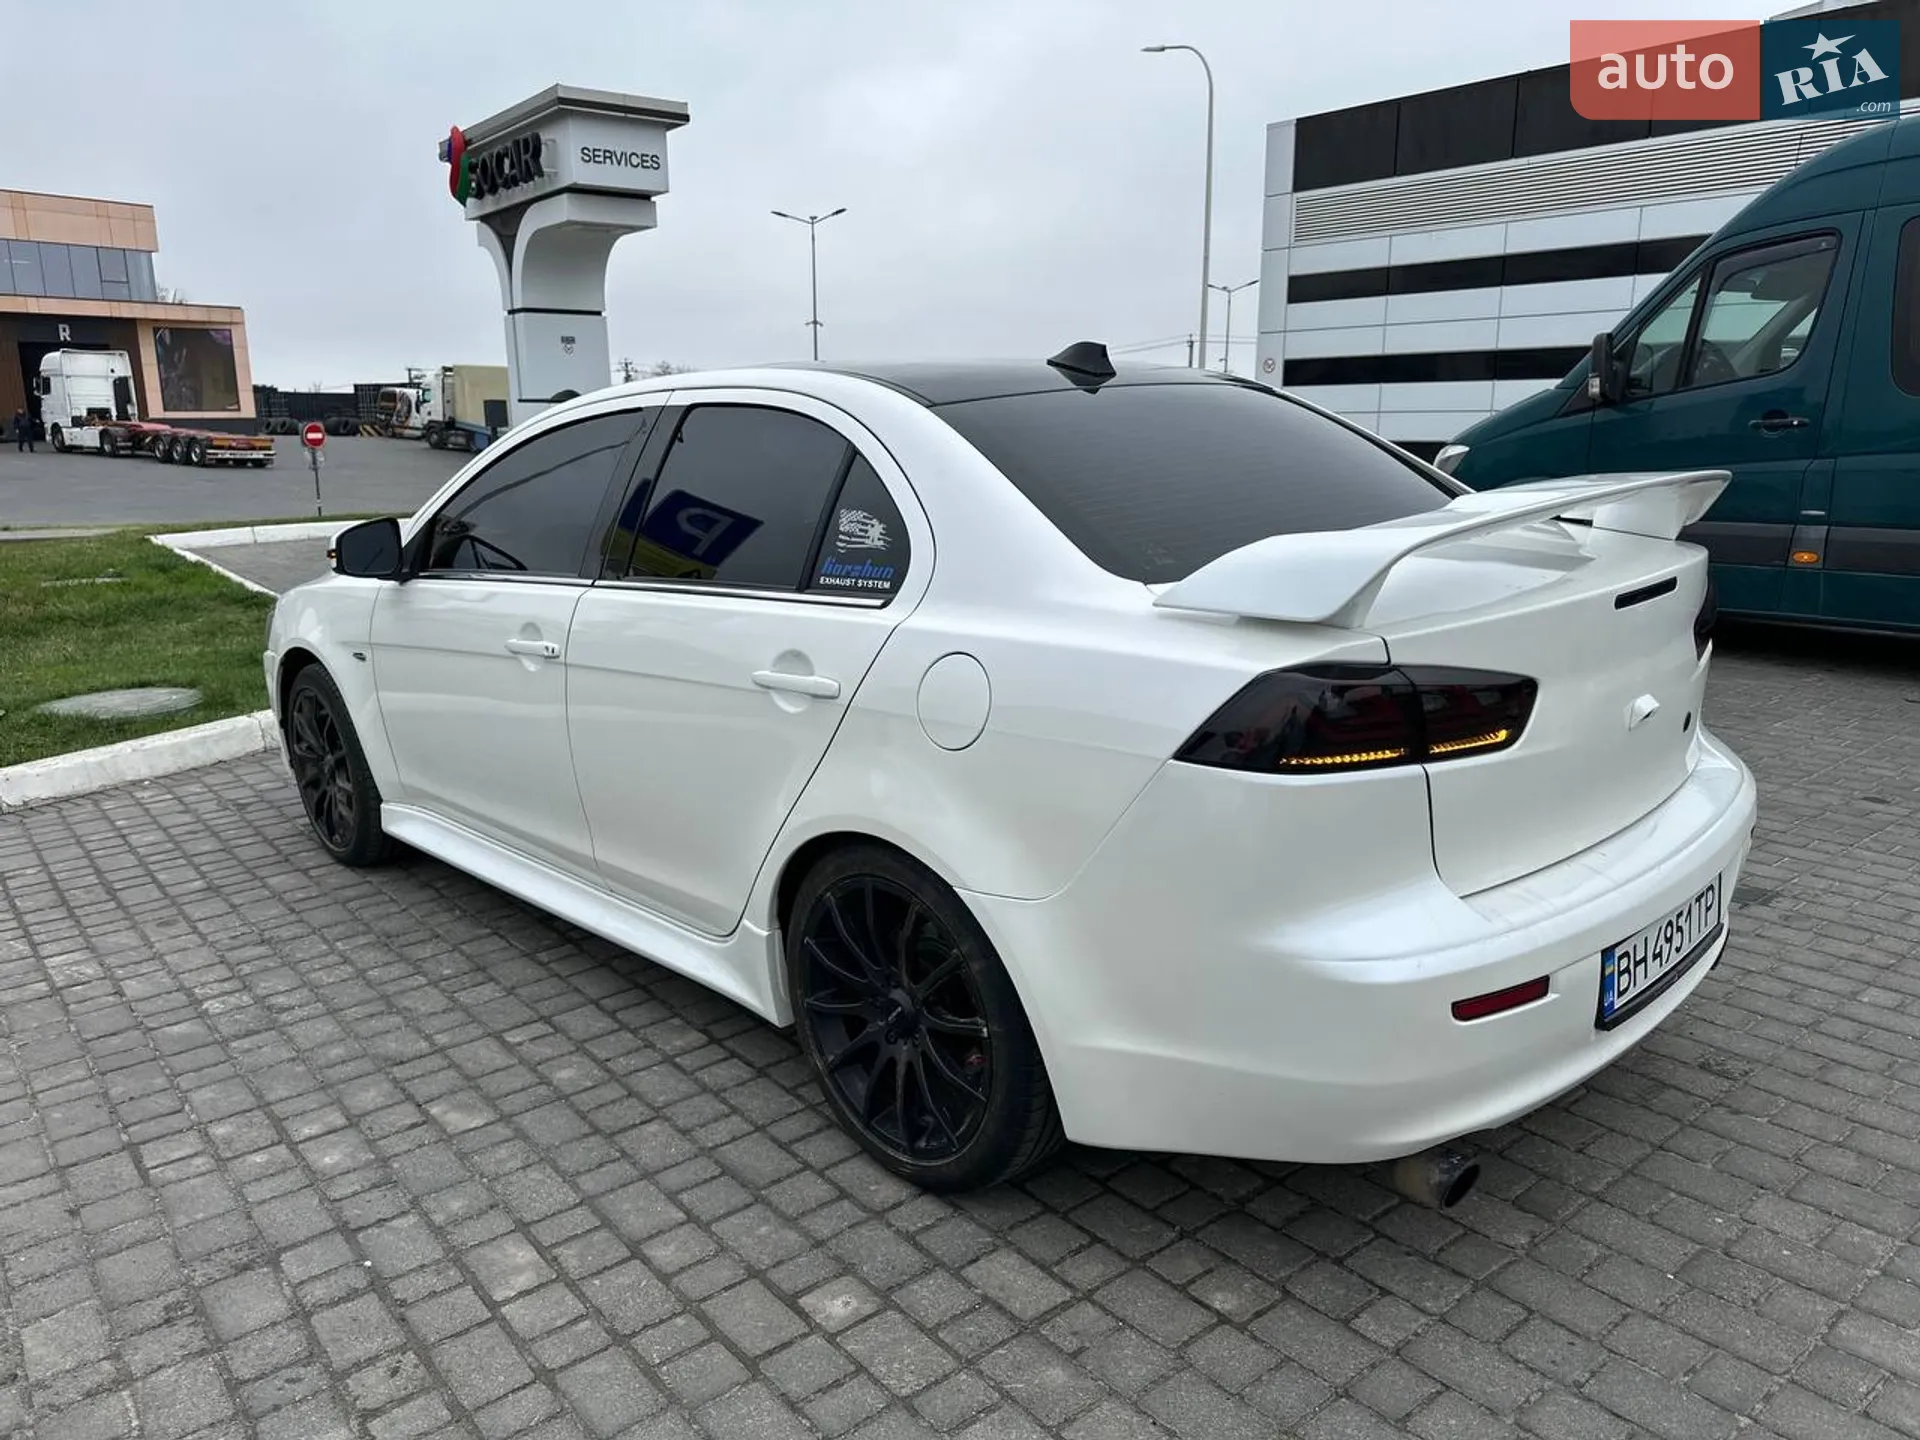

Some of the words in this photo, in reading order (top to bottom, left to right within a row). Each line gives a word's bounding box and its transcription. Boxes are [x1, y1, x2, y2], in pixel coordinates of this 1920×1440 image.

[467, 132, 544, 200] SOCAR
[580, 146, 661, 171] SERVICES
[59, 324, 72, 341] R
[820, 576, 856, 587] EXHAUST
[857, 579, 891, 589] SYSTEM
[1617, 935, 1649, 999] BH
[1652, 902, 1693, 969] 4951
[1695, 884, 1716, 935] TP
